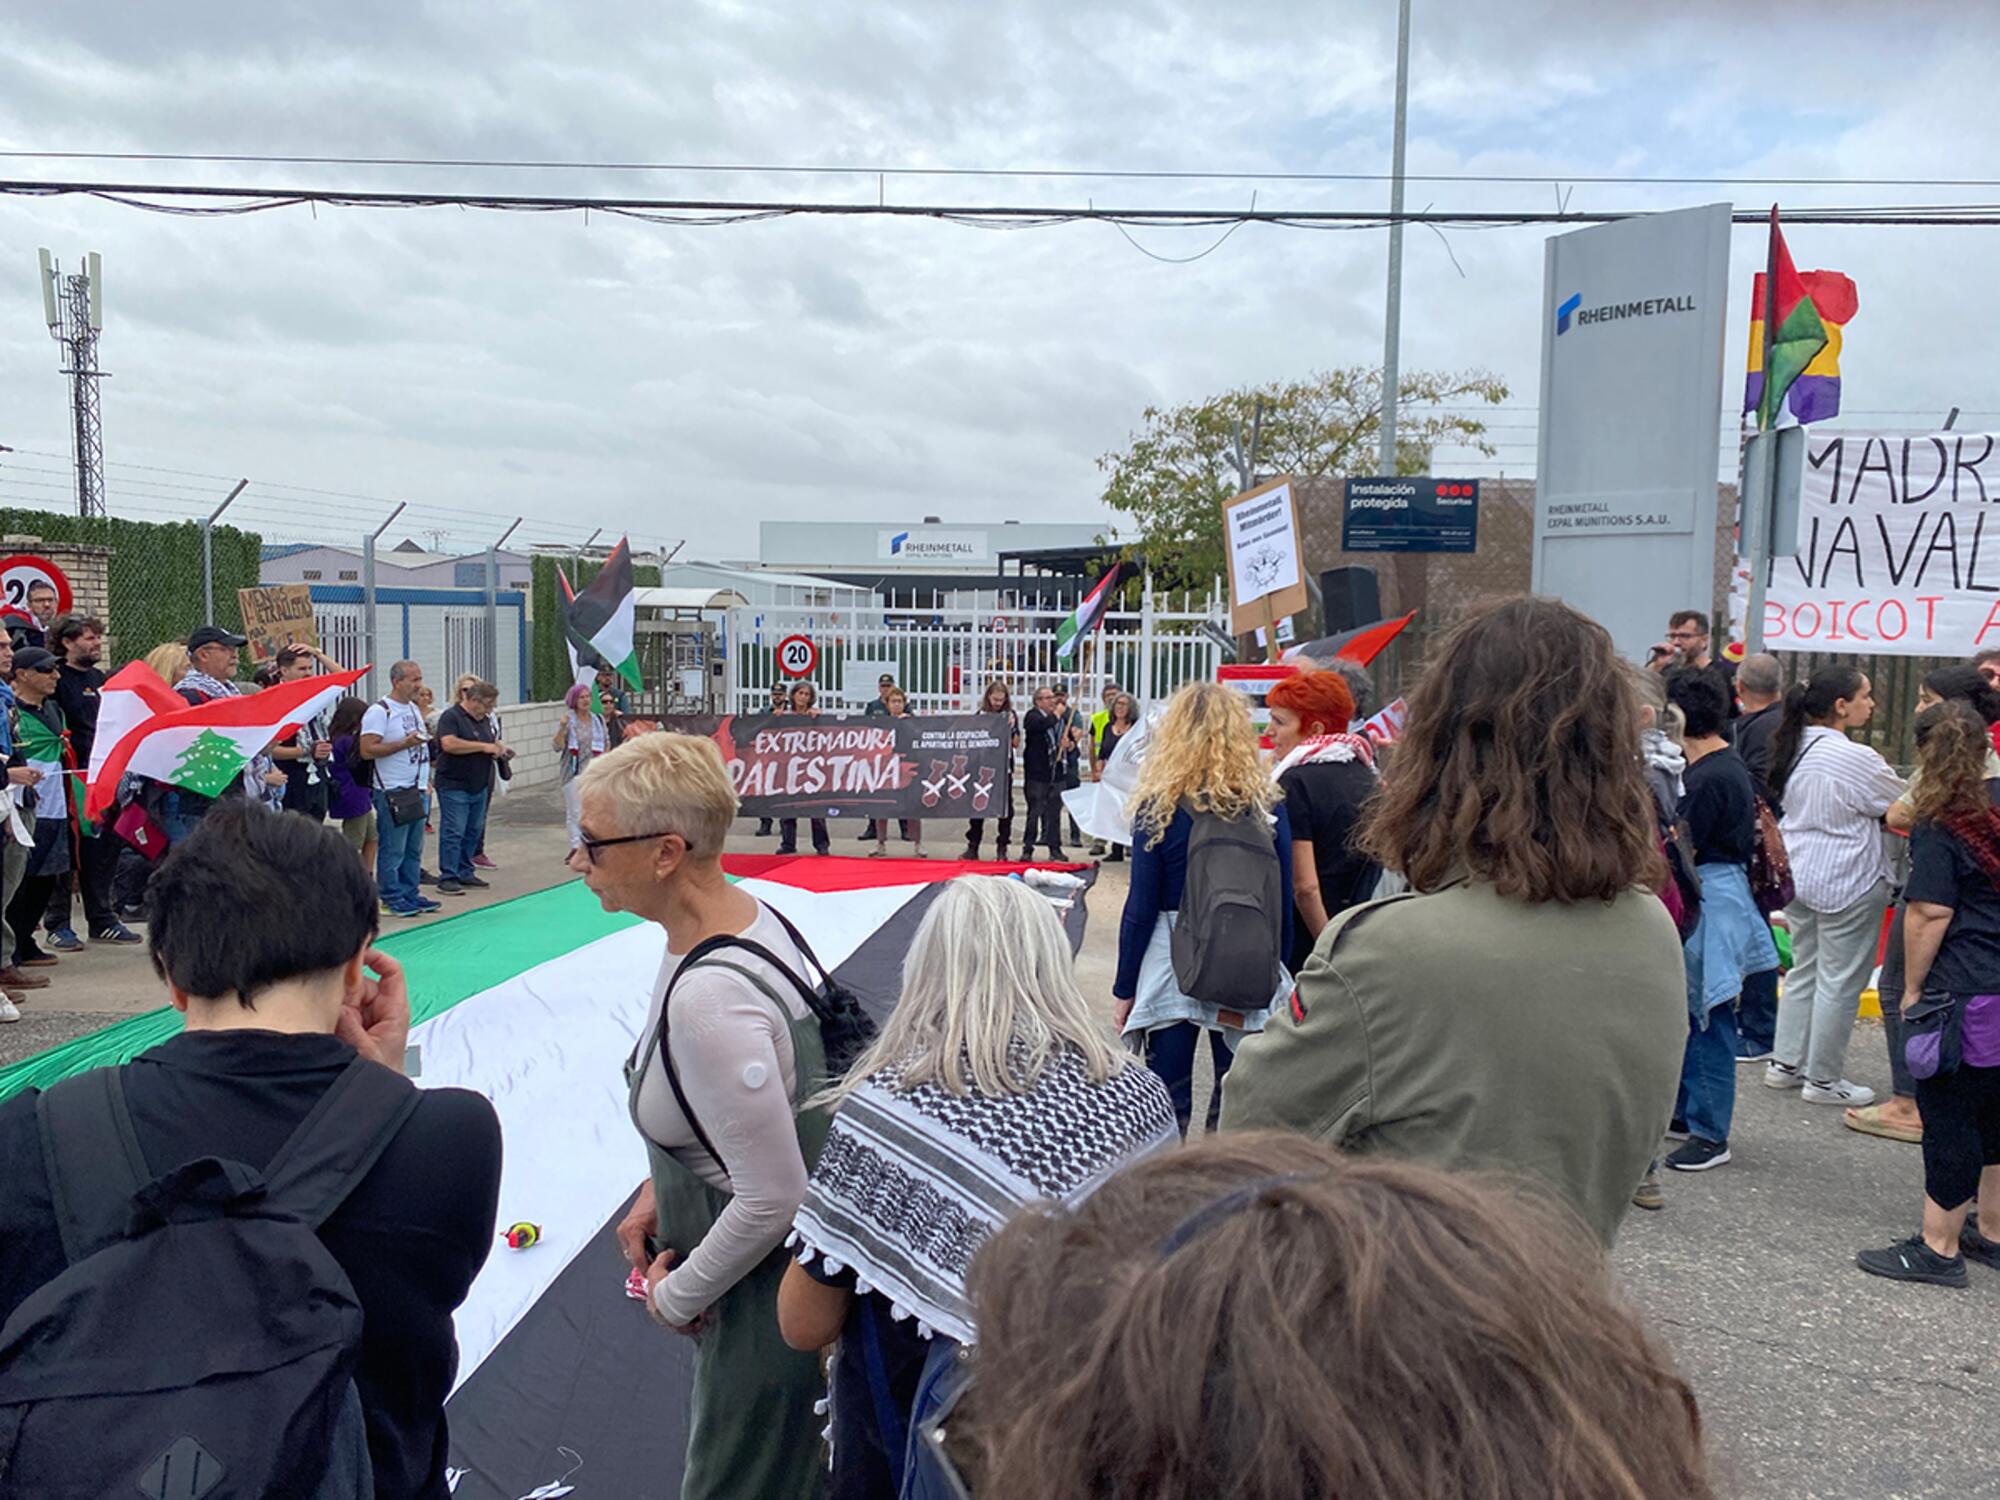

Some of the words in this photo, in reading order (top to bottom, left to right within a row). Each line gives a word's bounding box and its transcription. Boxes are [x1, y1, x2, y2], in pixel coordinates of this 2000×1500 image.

[1578, 295, 1696, 325] RHEINMETALL
[1808, 435, 2000, 504] MADR
[1351, 483, 1416, 496] Instalación
[1350, 497, 1408, 510] protegida
[1436, 497, 1473, 505] Securitas
[1548, 502, 1609, 515] RHEINMETALL
[1575, 515, 1633, 527] MUNITIONS
[1635, 514, 1671, 526] S.A.U.
[905, 542, 973, 553] RHEINMETALL
[1762, 596, 1944, 641] BOICOT
[788, 645, 808, 664] 20
[755, 728, 896, 754] EXTREMADURA
[727, 753, 901, 796] PALESTINA
